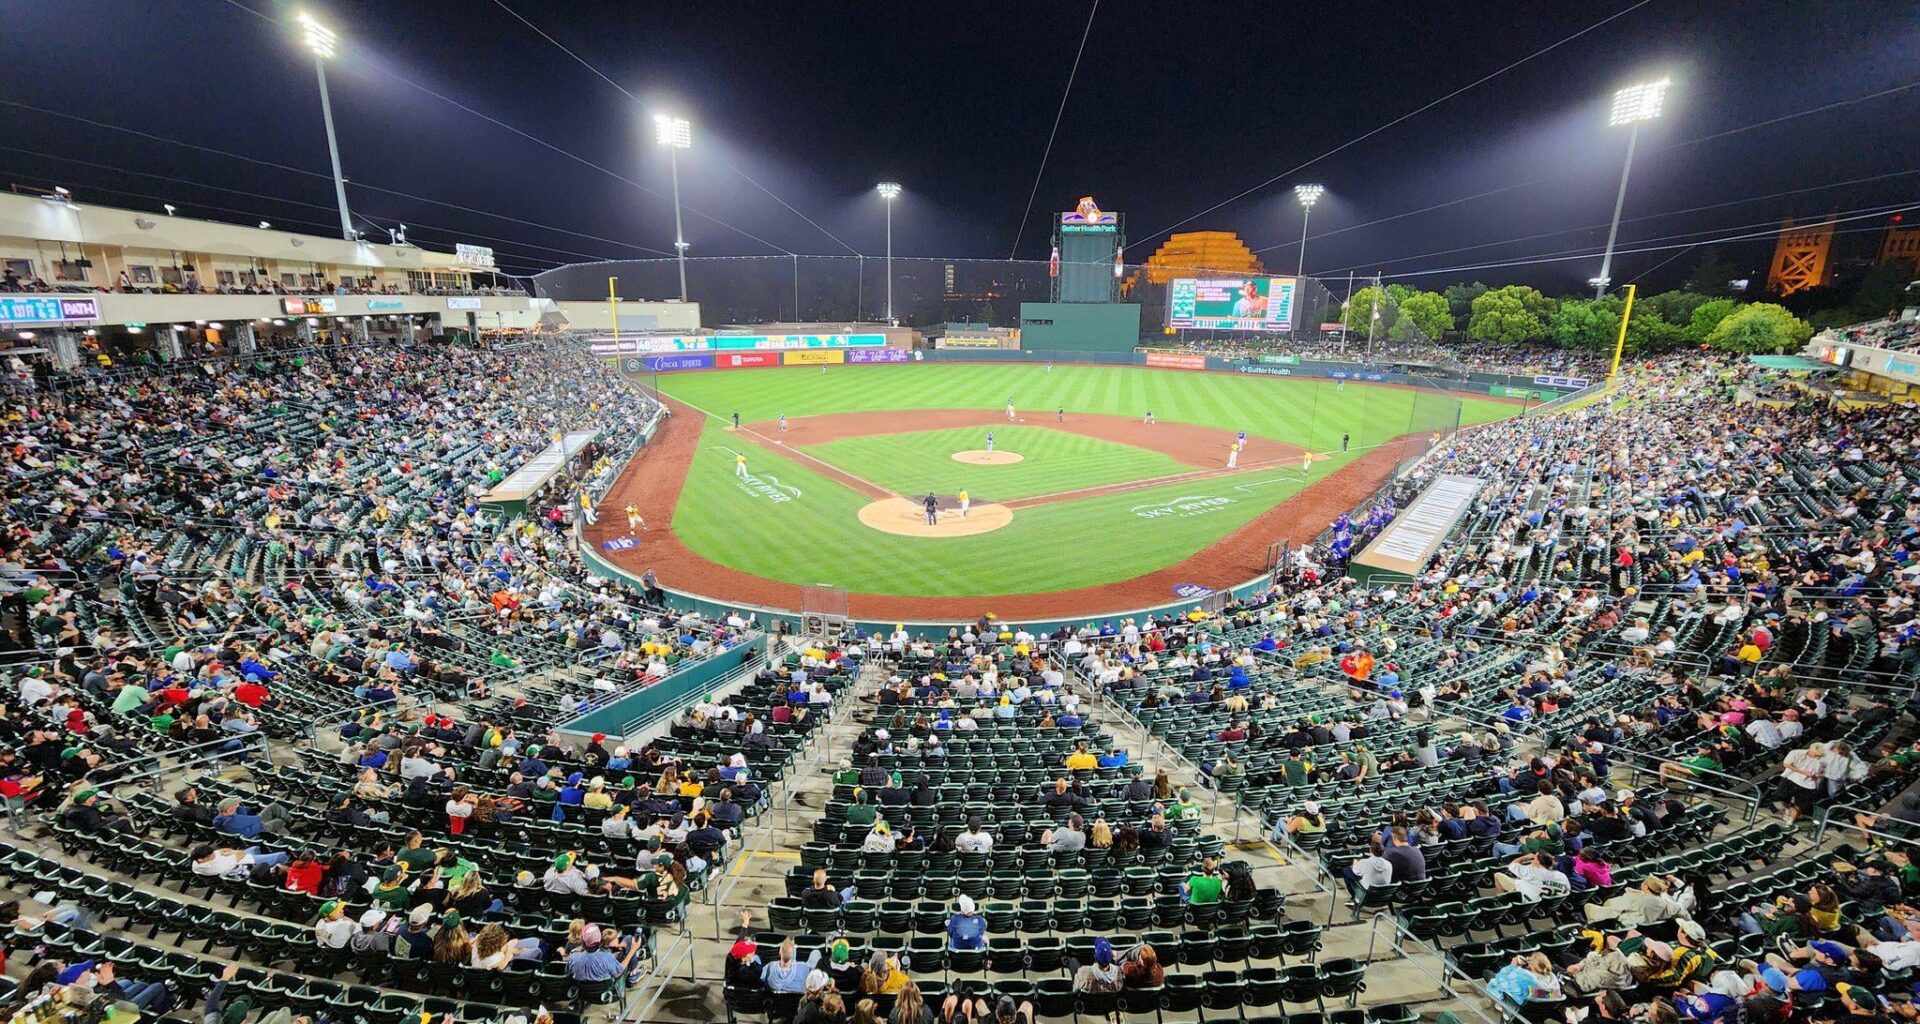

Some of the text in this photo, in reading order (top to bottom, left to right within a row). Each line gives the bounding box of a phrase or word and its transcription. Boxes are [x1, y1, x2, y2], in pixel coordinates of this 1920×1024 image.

[1247, 366, 1291, 375] Sutter Health
[1136, 497, 1230, 519] SKY RIVER
